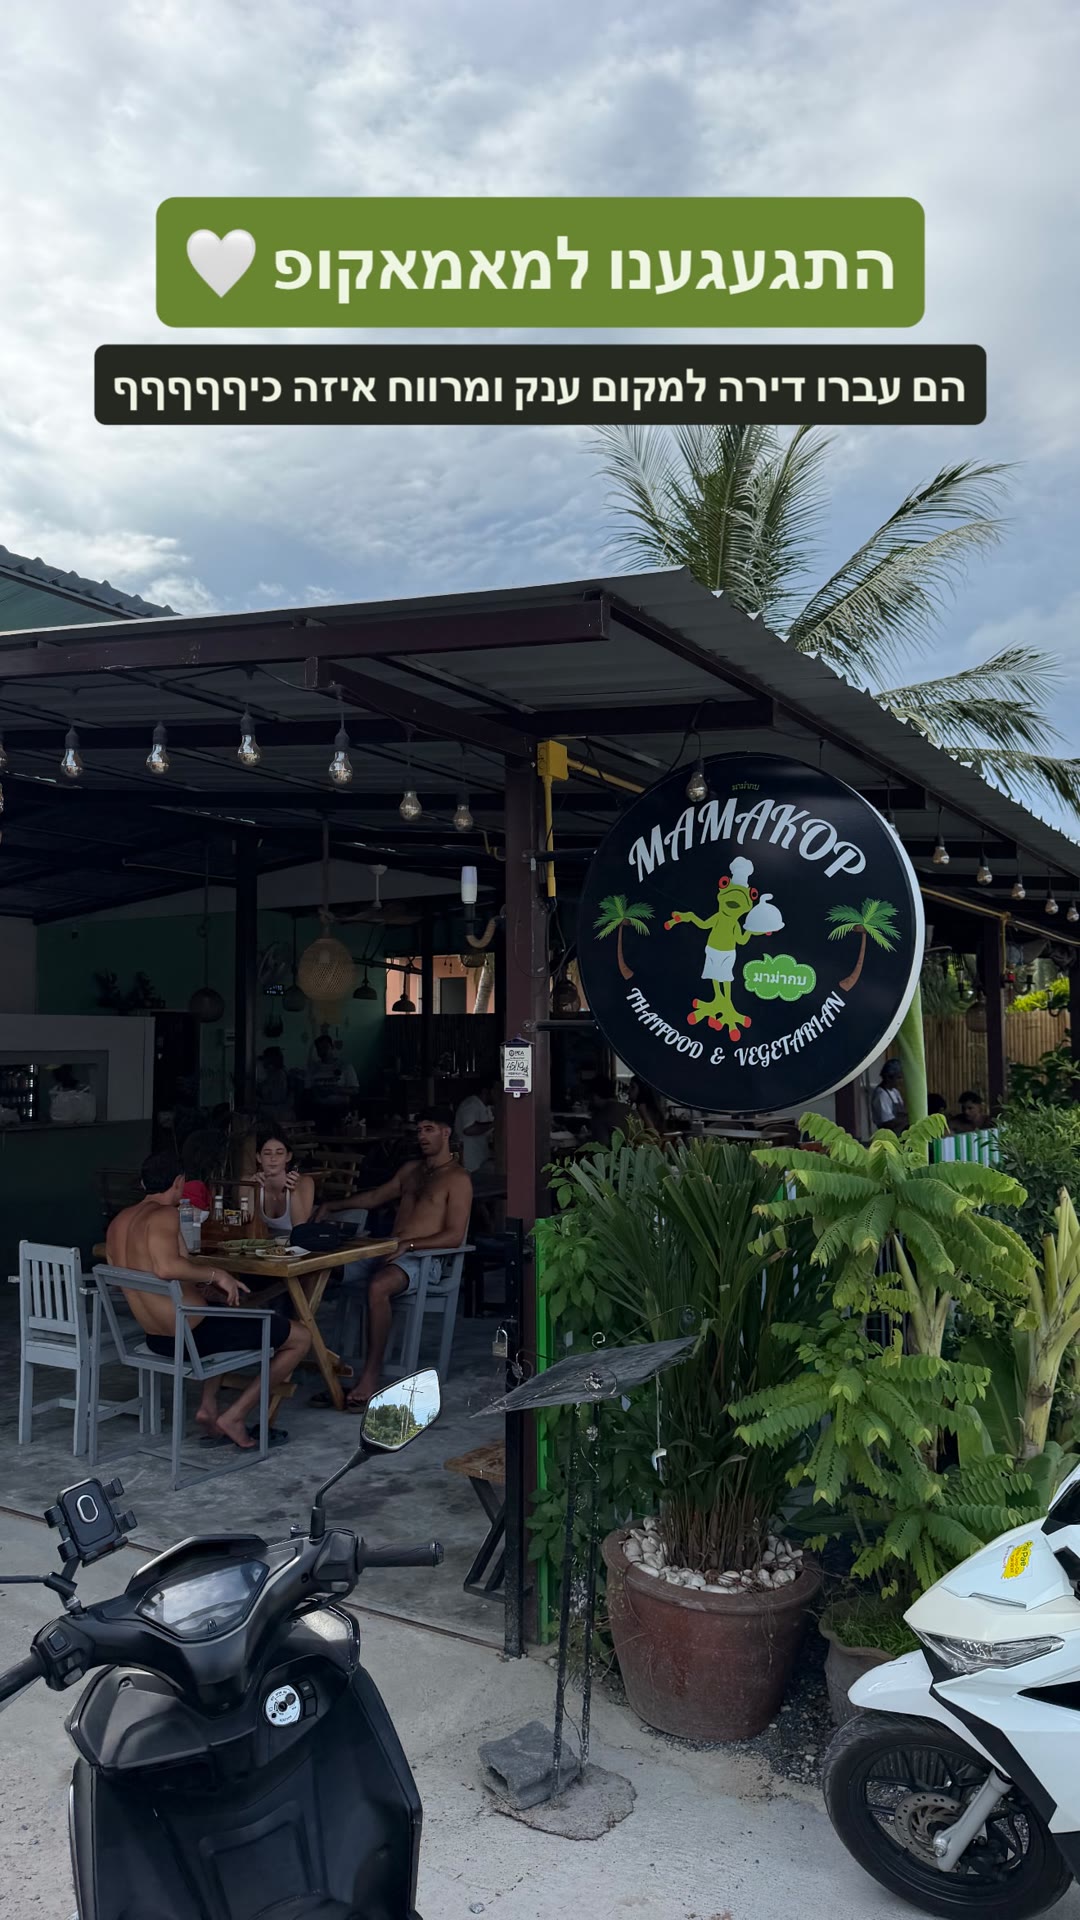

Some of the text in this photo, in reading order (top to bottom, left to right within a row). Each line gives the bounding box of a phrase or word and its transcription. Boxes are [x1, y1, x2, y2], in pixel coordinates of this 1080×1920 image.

[628, 797, 867, 883] MAMAKOP
[752, 970, 808, 987] มาม่ากบ
[626, 987, 847, 1069] THAIFOOD & VEGETARIAN
